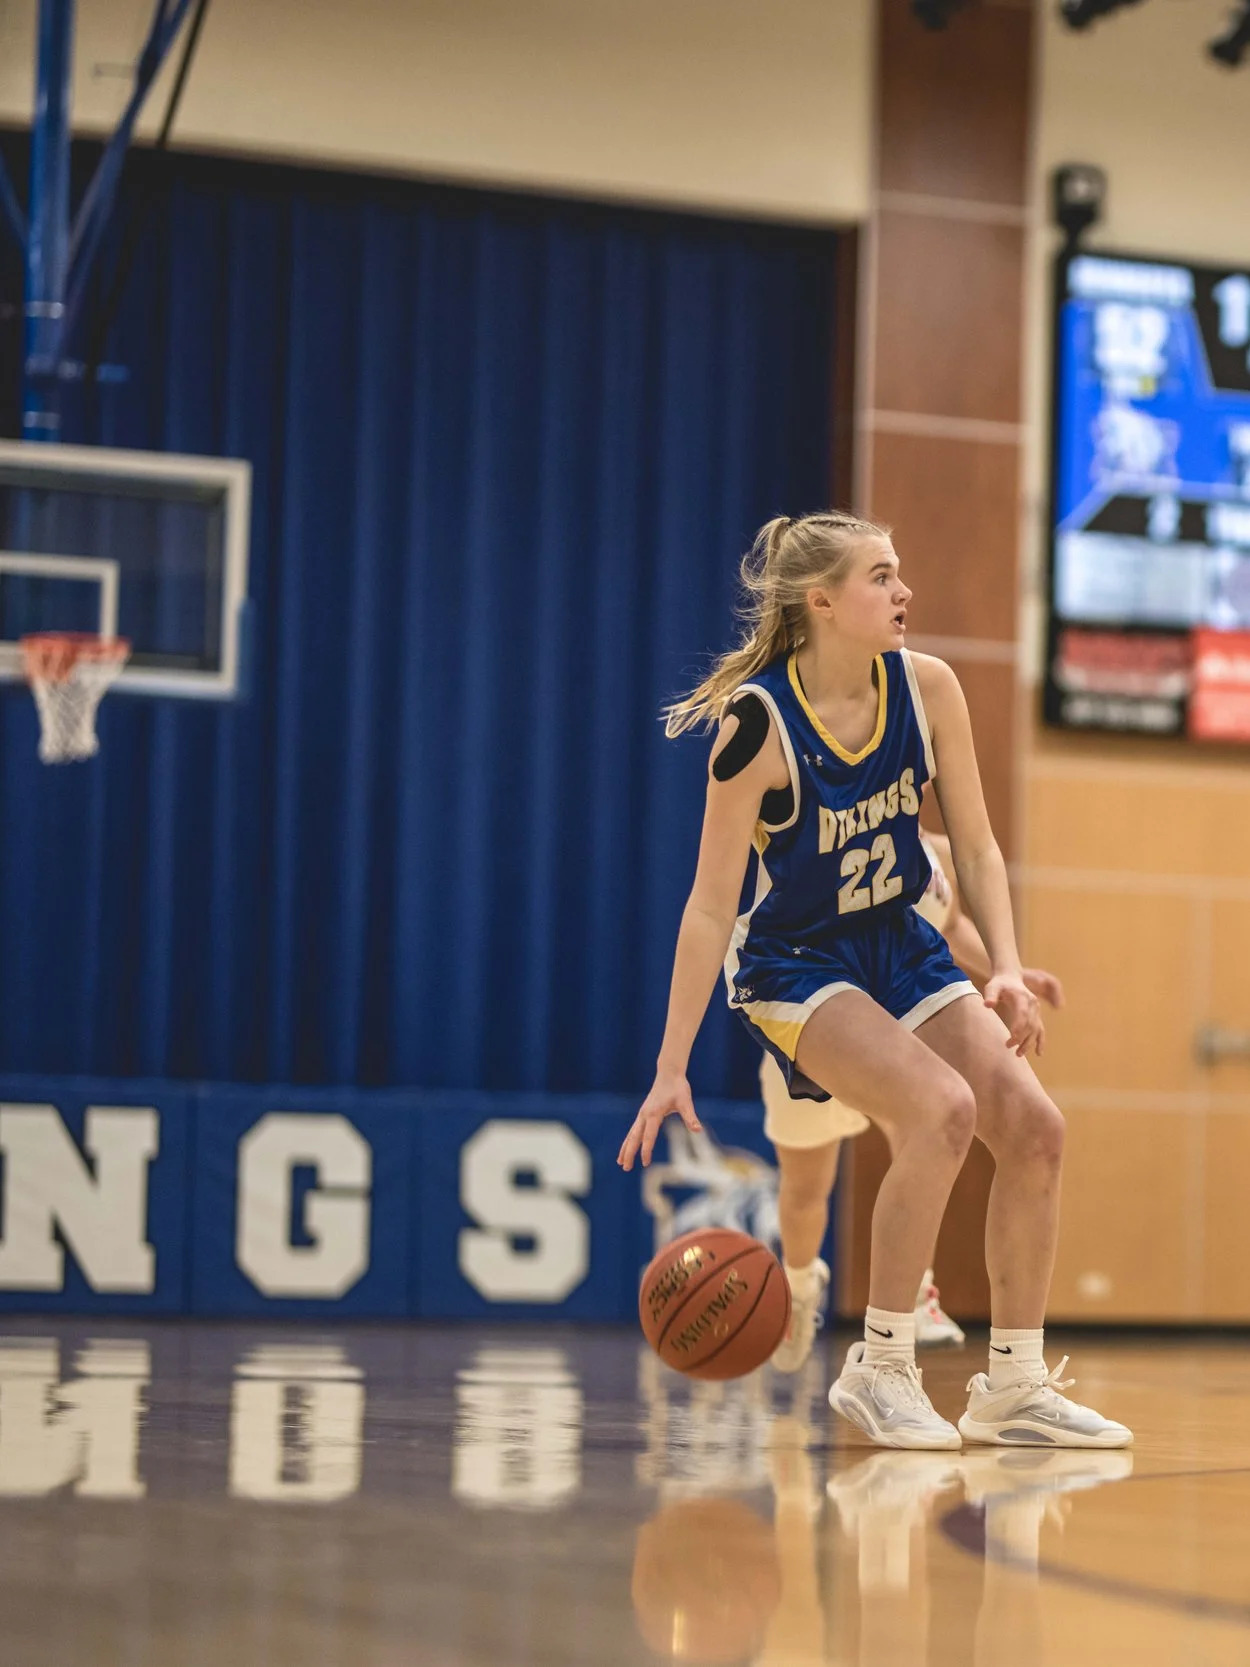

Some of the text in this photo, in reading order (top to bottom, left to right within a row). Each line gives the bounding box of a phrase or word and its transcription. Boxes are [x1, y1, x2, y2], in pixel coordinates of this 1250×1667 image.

[838, 833, 903, 915] 22
[0, 1102, 592, 1303] NGS
[670, 1269, 749, 1353] SPALDING
